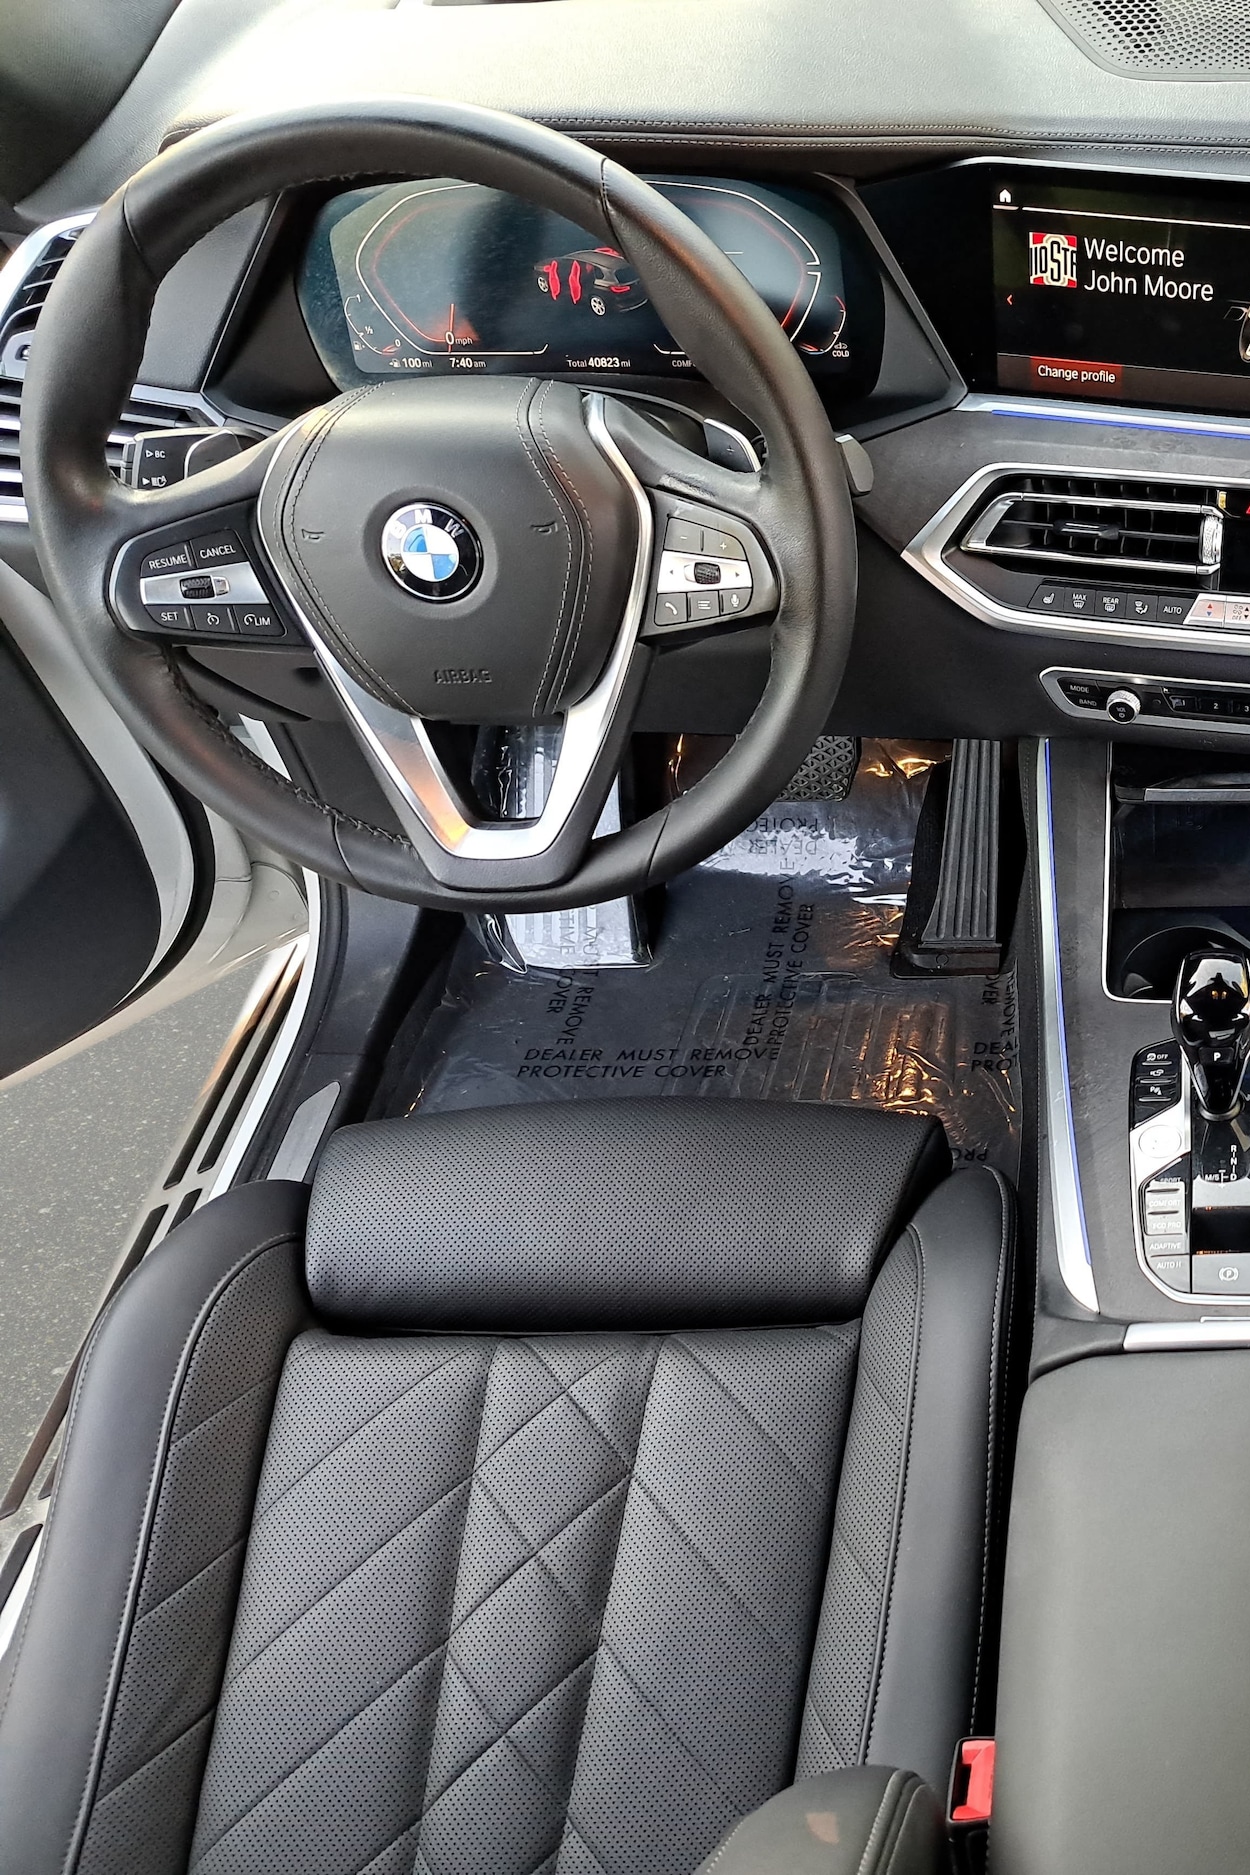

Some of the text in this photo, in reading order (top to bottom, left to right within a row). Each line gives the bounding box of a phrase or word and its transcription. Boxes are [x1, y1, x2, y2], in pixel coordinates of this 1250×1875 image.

[1084, 237, 1185, 268] Welcome
[1084, 270, 1214, 301] John Moore
[394, 339, 401, 347] 0
[445, 332, 473, 346] 0 mph
[832, 350, 850, 358] COLD
[402, 357, 433, 368] 100 mi
[449, 357, 486, 368] 7:40 am
[567, 357, 631, 368] Total 40823 mi
[1038, 365, 1115, 383] Change profile
[154, 450, 166, 459] BC
[389, 508, 465, 539] BMW
[200, 545, 236, 559] CANCEL
[149, 554, 187, 569] RESUME
[1072, 593, 1087, 602] MAX
[1102, 597, 1119, 605] REAR
[1163, 605, 1182, 614] AUTO
[161, 611, 179, 621] SET
[255, 617, 271, 627] LIM
[433, 668, 493, 684] AIRBAG
[1069, 684, 1090, 694] MODE
[1244, 705, 1249, 713] 3
[743, 858, 795, 1046] DEALER MUST REMOVE
[767, 903, 814, 1045] PROTECTIVE COVER
[556, 987, 594, 1045] REMOVE
[524, 1048, 781, 1061] DEALER MUST REMOVE
[1214, 1052, 1221, 1061] P
[517, 1065, 727, 1078] PROTECTIVE COVER
[1149, 1242, 1181, 1250] ADAPTIVE
[1157, 1261, 1175, 1269] AUTO
